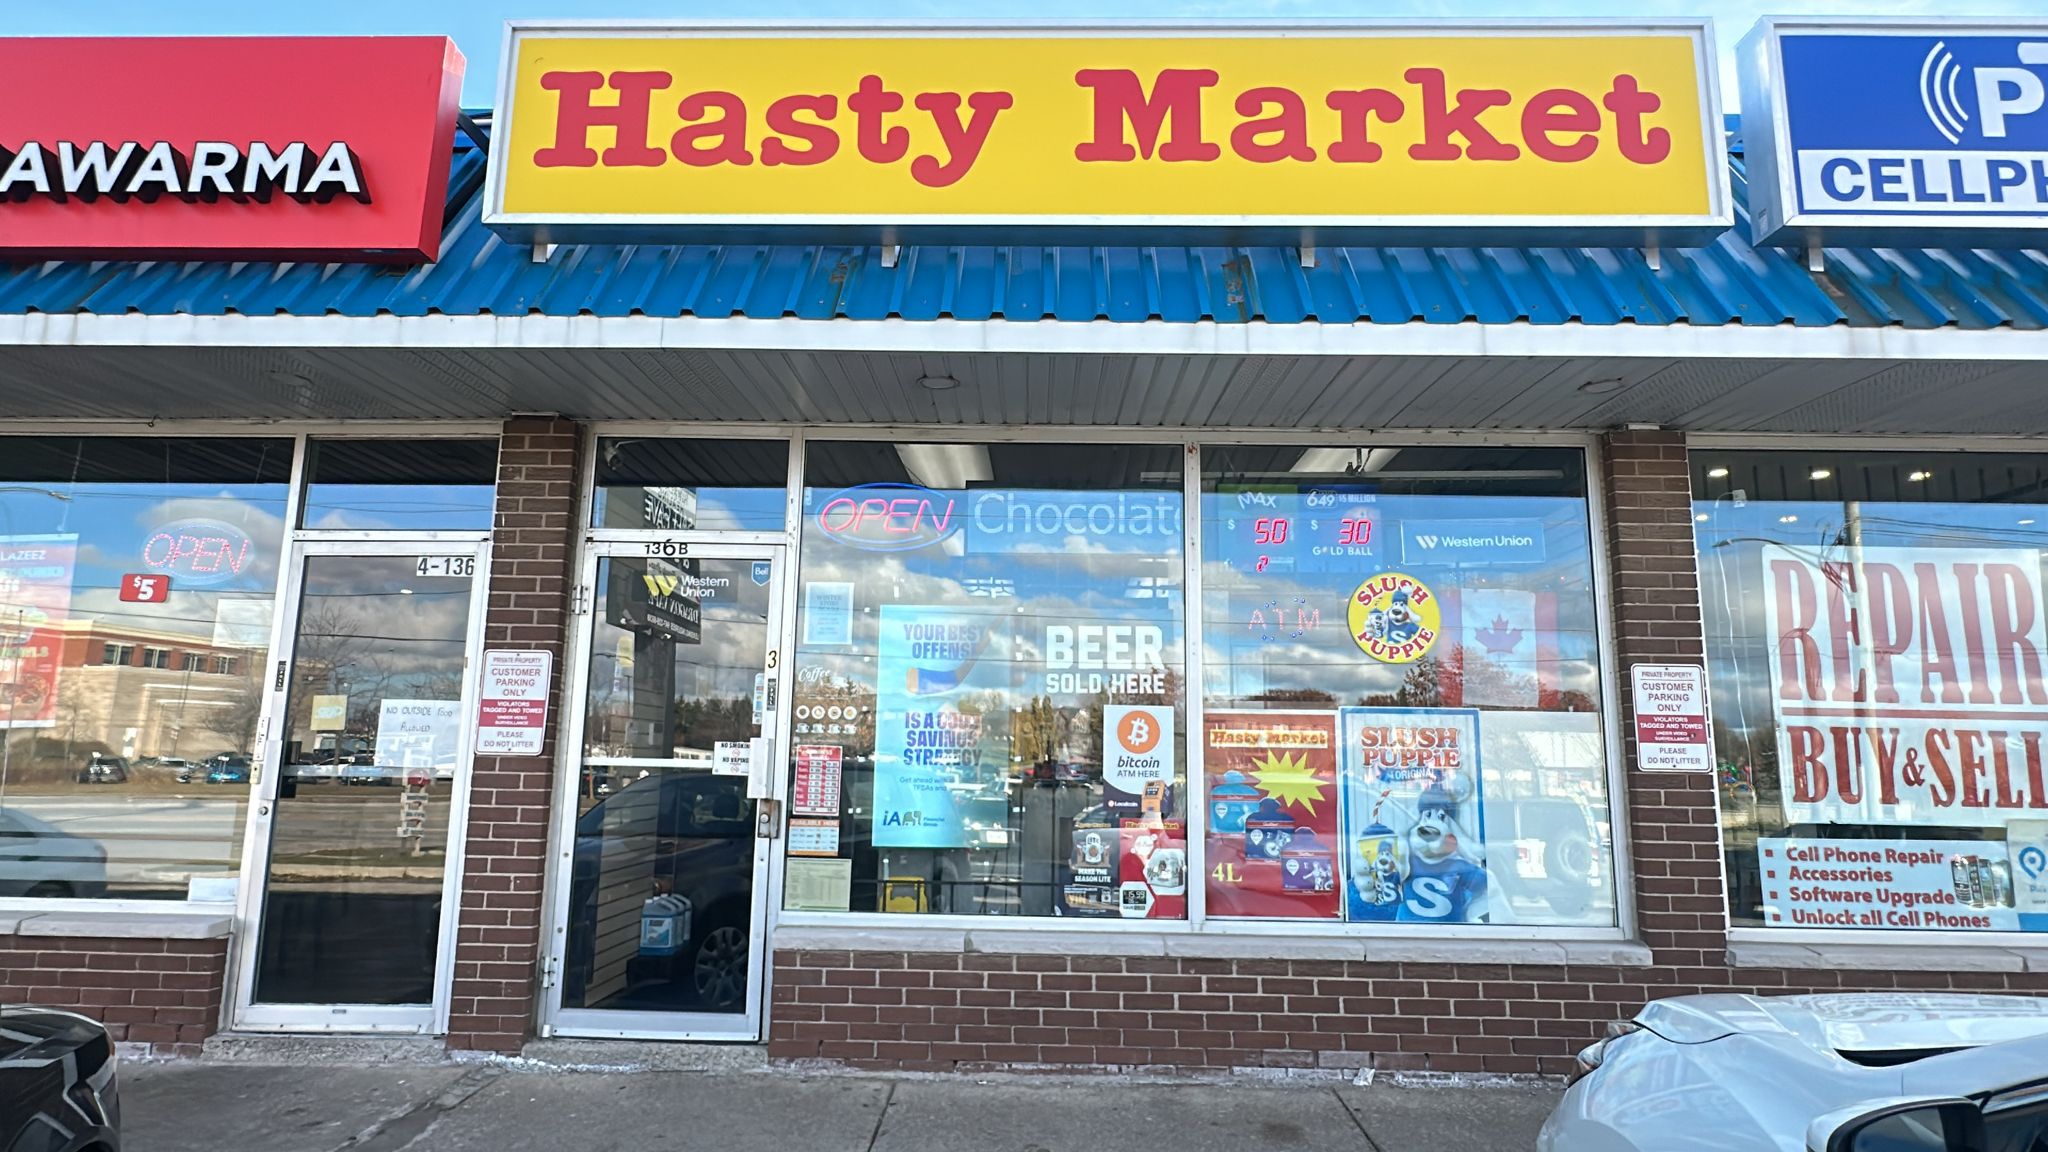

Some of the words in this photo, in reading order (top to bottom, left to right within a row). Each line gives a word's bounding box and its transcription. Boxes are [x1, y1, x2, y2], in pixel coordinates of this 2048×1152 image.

[533, 71, 1013, 187] Hasty
[1074, 68, 1671, 164] Market
[0, 141, 361, 193] AWARMA
[1237, 491, 1277, 509] MAX
[1306, 491, 1336, 507] 649
[820, 498, 954, 533] OPEN
[1254, 518, 1288, 544] 50
[1339, 518, 1372, 544] 30
[1441, 535, 1493, 547] Western
[1495, 535, 1533, 547] Union
[144, 533, 249, 575] OPEN
[1348, 547, 1373, 556] BALL
[418, 557, 475, 575] 4-136
[755, 567, 769, 575] Bell
[133, 575, 157, 600] $5
[681, 575, 729, 587] Western
[681, 587, 715, 598] Union
[1248, 608, 1321, 631] ATM
[903, 624, 945, 640] YOUR
[1771, 560, 2048, 705] REPAIR
[1046, 625, 1165, 670] BEER
[1357, 628, 1434, 660] PUPPIE
[768, 650, 778, 669] 3
[491, 668, 541, 676] CUSTOMER
[798, 665, 831, 682] Coffee
[496, 679, 535, 687] PARKING
[1046, 674, 1102, 694] SOLD
[1111, 673, 1165, 694] HERE
[1642, 682, 1693, 691] CUSTOMER
[1648, 693, 1690, 701] PARKING
[386, 706, 398, 714] NO
[402, 706, 431, 715] OUTSIDE
[905, 712, 921, 729] IS
[923, 712, 934, 729] A
[907, 730, 978, 747] SAVINGS
[1211, 731, 1260, 744] Hasty
[1265, 731, 1326, 744] Market
[1361, 727, 1459, 748] SLUSH
[903, 748, 982, 766] STRATEGY
[1117, 756, 1160, 768] bitcoin
[1787, 726, 1900, 804] BUY
[882, 810, 901, 826] iA
[1786, 846, 1819, 861] Cell
[1823, 847, 1881, 862] Phone
[1885, 848, 1944, 867] Repair
[1211, 863, 1243, 882] 4L
[1789, 866, 1893, 882] Accessories
[1789, 886, 1872, 902] Software
[1876, 888, 1956, 908] Upgrade
[1792, 909, 1857, 925] Unlock
[1860, 910, 1883, 926] all
[1886, 910, 1919, 926] Cell
[1924, 911, 1991, 927] Phones
